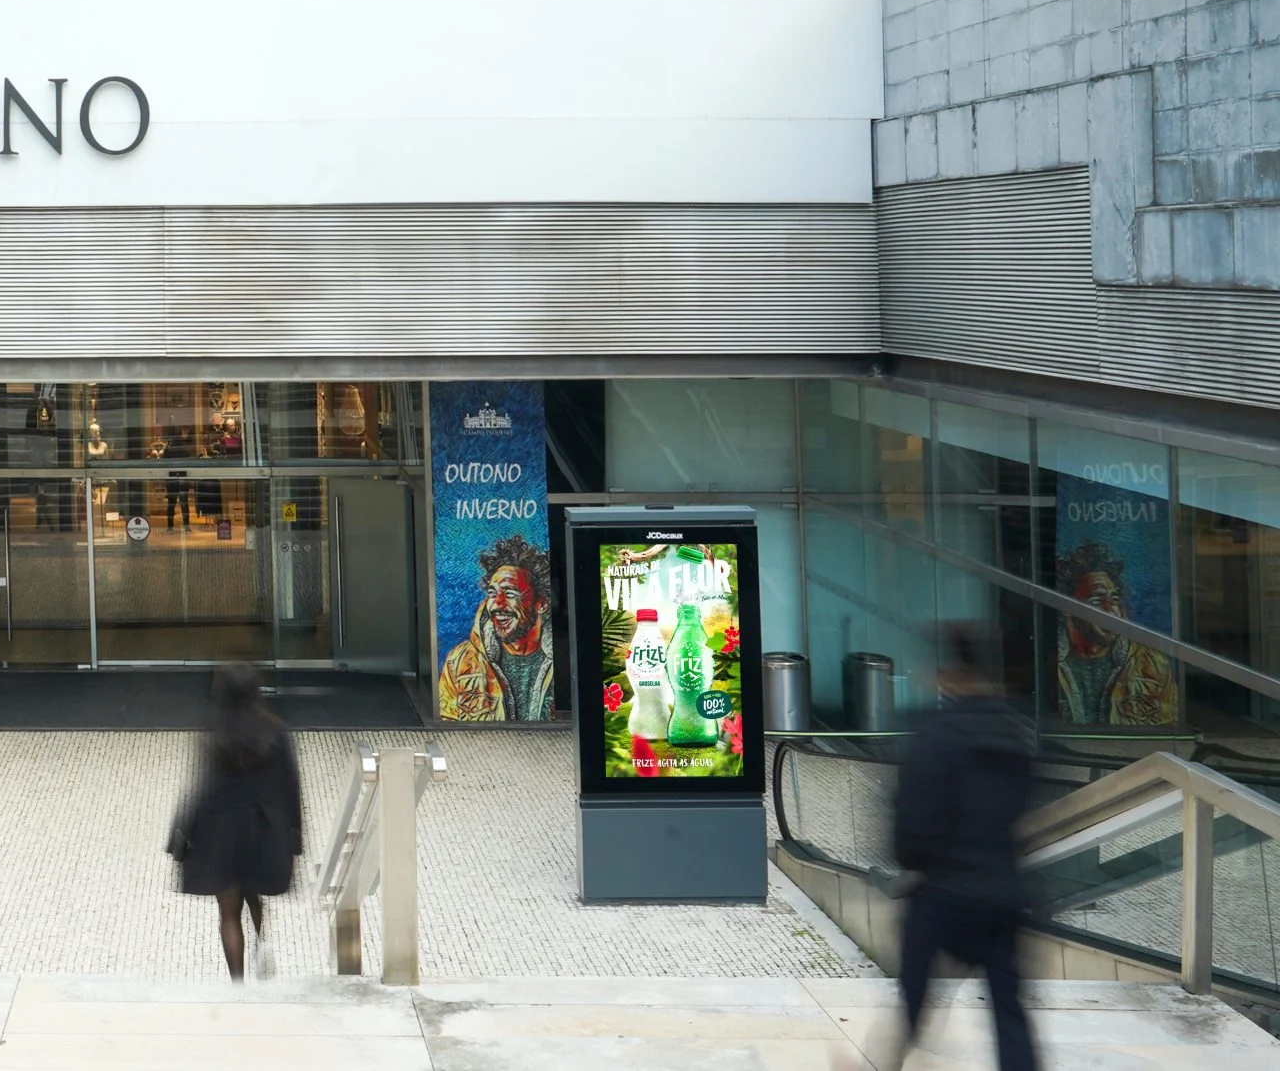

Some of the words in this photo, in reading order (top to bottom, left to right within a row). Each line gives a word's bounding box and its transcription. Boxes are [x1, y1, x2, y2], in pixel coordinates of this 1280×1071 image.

[445, 462, 521, 484] OUTONO
[456, 498, 537, 520] INVERNO
[646, 532, 684, 540] JCDecaux
[607, 562, 650, 577] NATURAIS
[668, 559, 733, 602] FLOR
[703, 697, 725, 711] 100%
[657, 758, 678, 768] AGITA
[679, 758, 689, 768] AS
